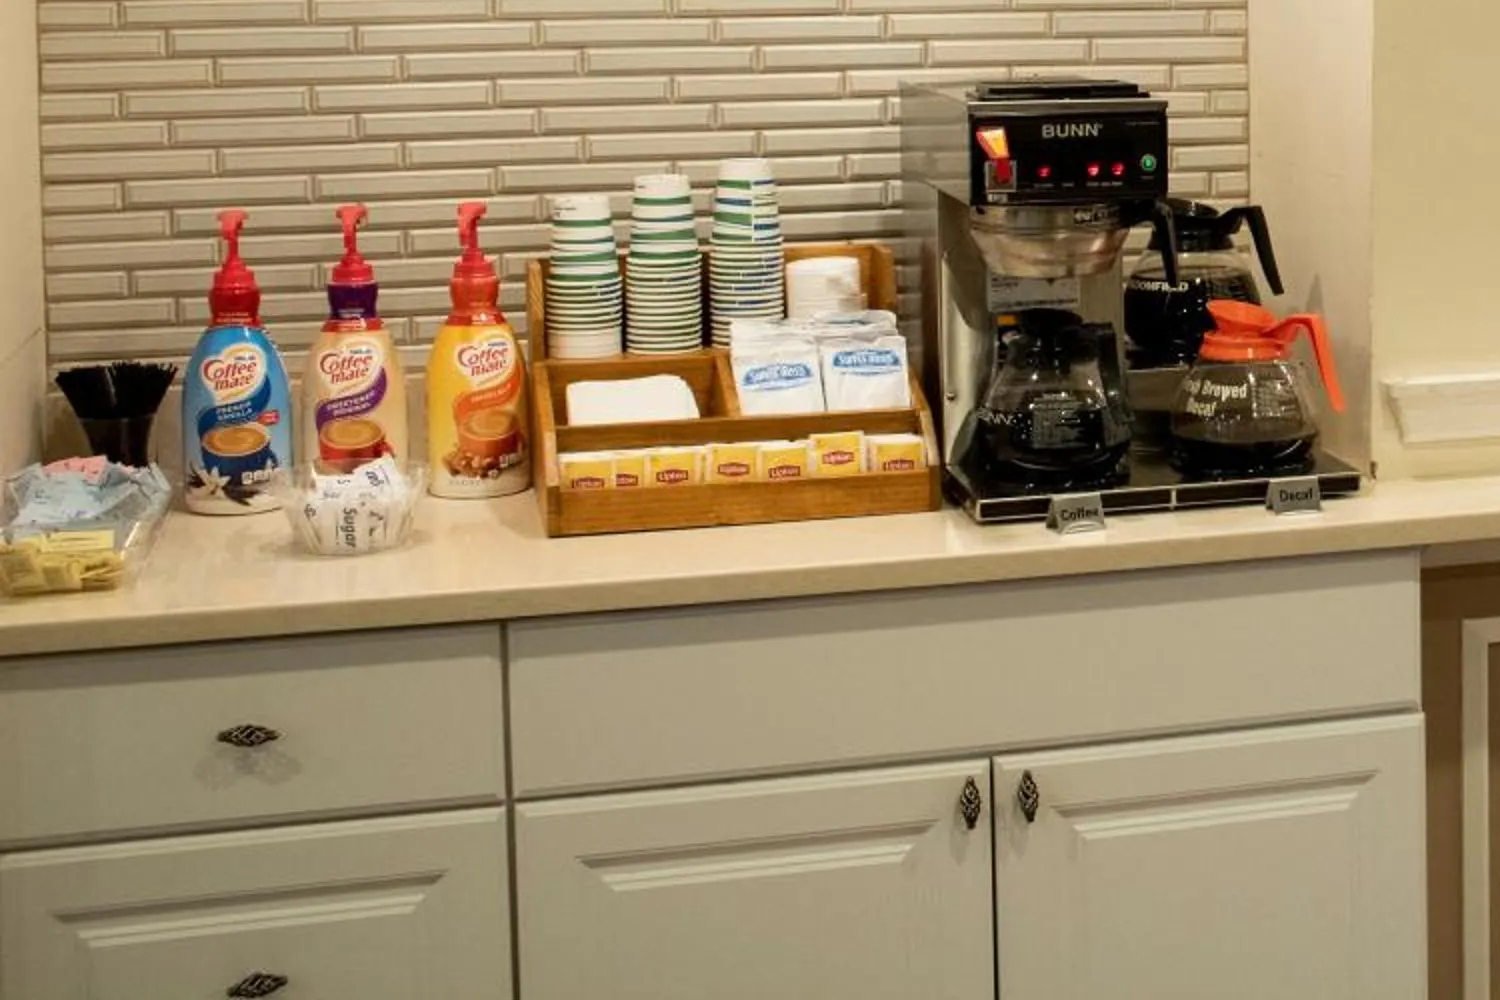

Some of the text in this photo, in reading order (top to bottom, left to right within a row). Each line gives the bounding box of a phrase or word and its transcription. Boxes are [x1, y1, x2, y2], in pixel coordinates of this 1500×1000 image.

[1041, 123, 1099, 138] BUNN
[320, 353, 373, 375] Coffee
[457, 345, 508, 368] Coffee
[203, 358, 257, 382] Coffee
[331, 367, 369, 385] mate
[470, 359, 507, 378] mate
[213, 374, 254, 392] mate
[1201, 379, 1248, 402] Brewed
[1279, 489, 1313, 502] Decaf
[1060, 507, 1099, 522] Coffee
[343, 507, 358, 548] Sugar
